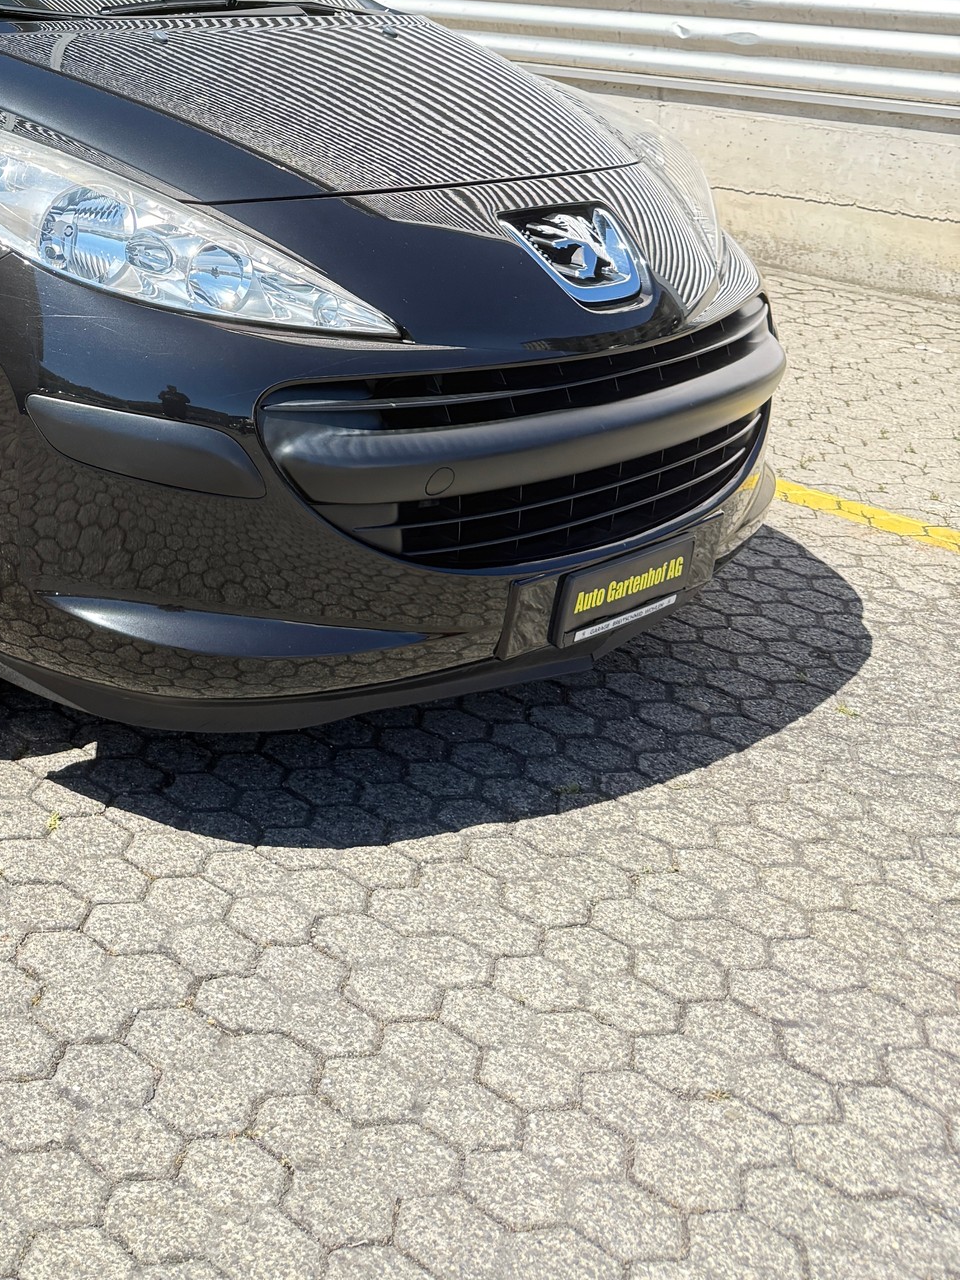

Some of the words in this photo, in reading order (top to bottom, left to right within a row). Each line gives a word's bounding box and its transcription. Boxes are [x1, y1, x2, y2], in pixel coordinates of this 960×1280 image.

[574, 588, 605, 614] Auto
[607, 562, 668, 602] Gartenhof
[666, 557, 684, 580] AG
